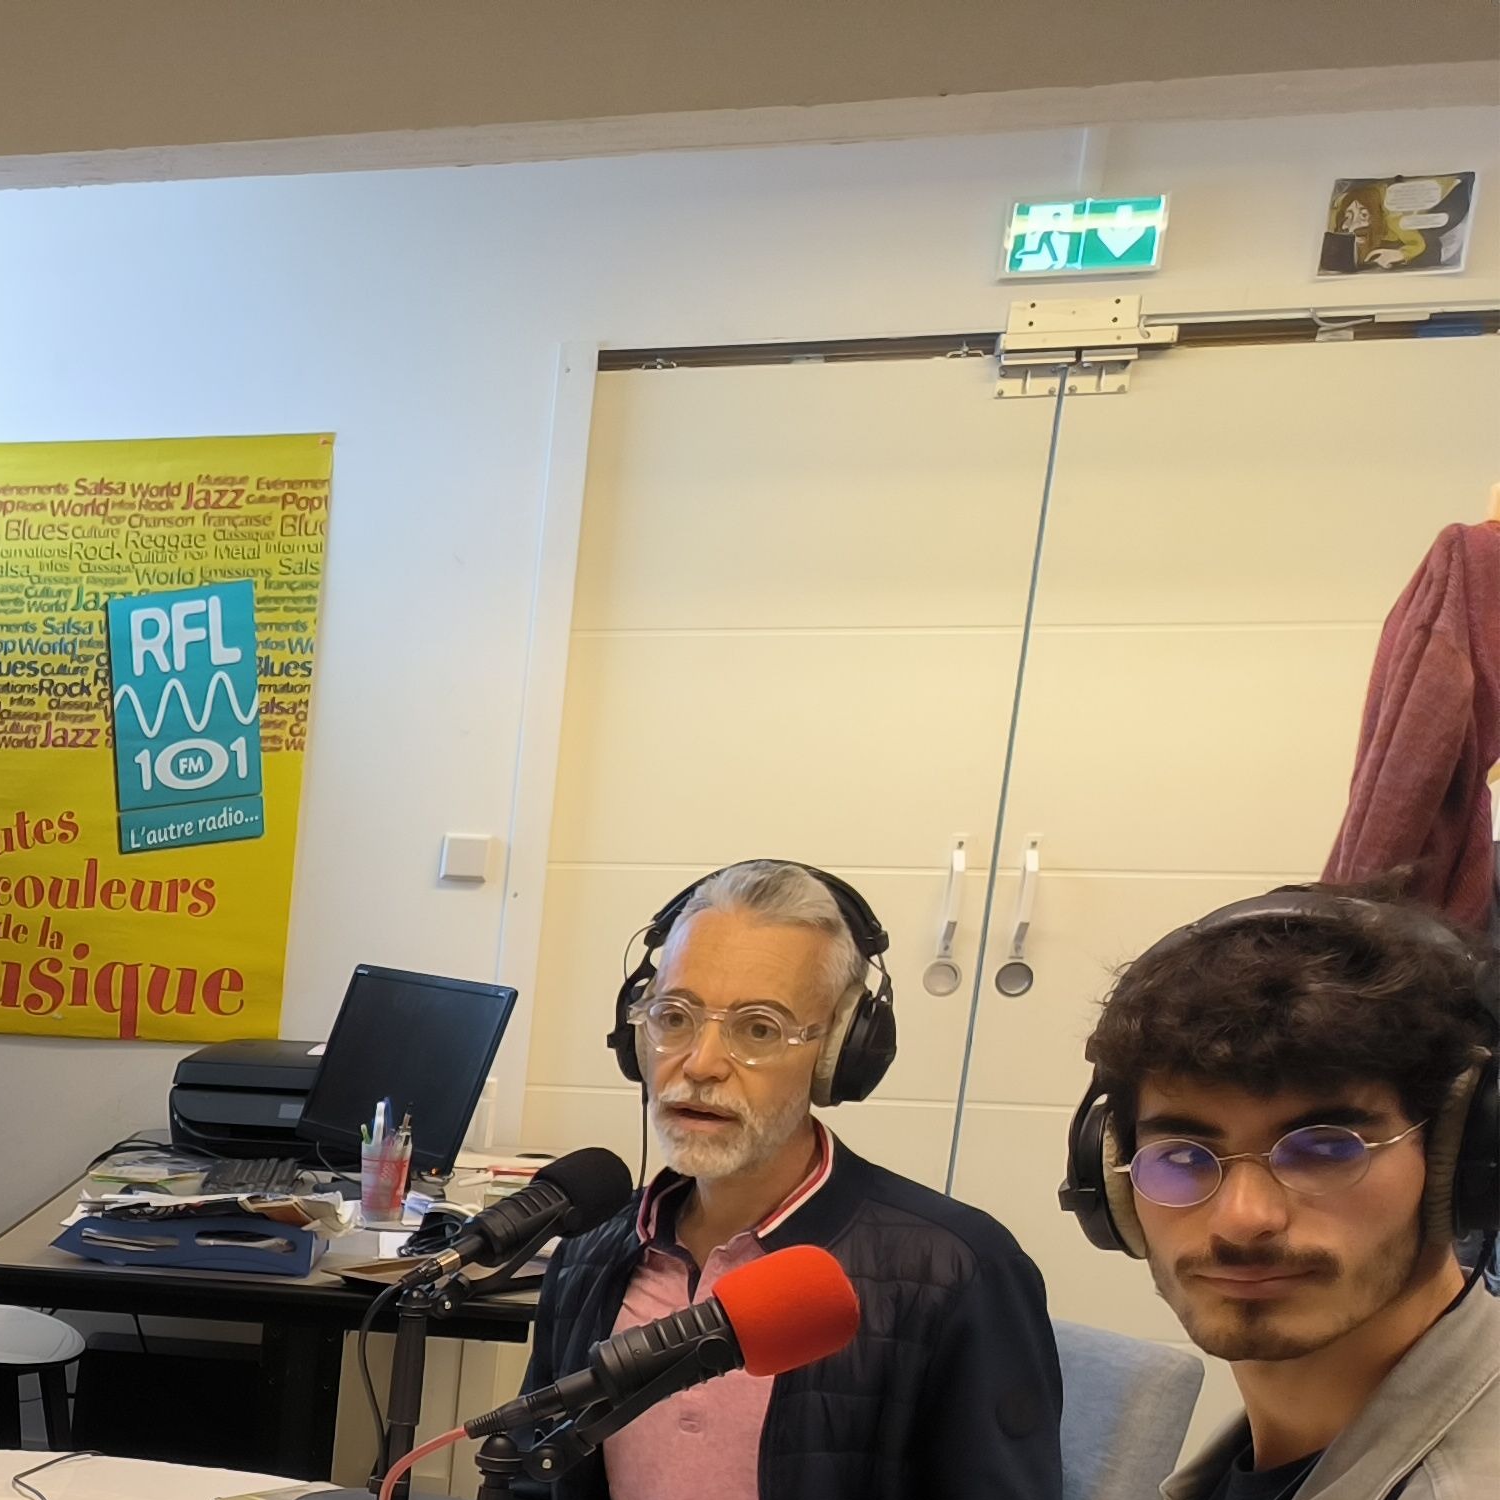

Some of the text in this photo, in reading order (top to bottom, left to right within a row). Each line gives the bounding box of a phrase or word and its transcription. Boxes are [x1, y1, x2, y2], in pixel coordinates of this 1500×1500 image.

[74, 477, 126, 496] Salsa
[181, 482, 246, 511] Jazz
[5, 518, 70, 542] Blues
[42, 616, 93, 635] Salsa
[129, 595, 242, 677] RFL
[19, 637, 78, 656] World
[38, 678, 92, 698] Rock
[40, 721, 101, 749] Jazz
[134, 736, 249, 792] 101
[178, 758, 205, 776] FM
[130, 808, 260, 850] L'autre radio...
[37, 917, 64, 951] la
